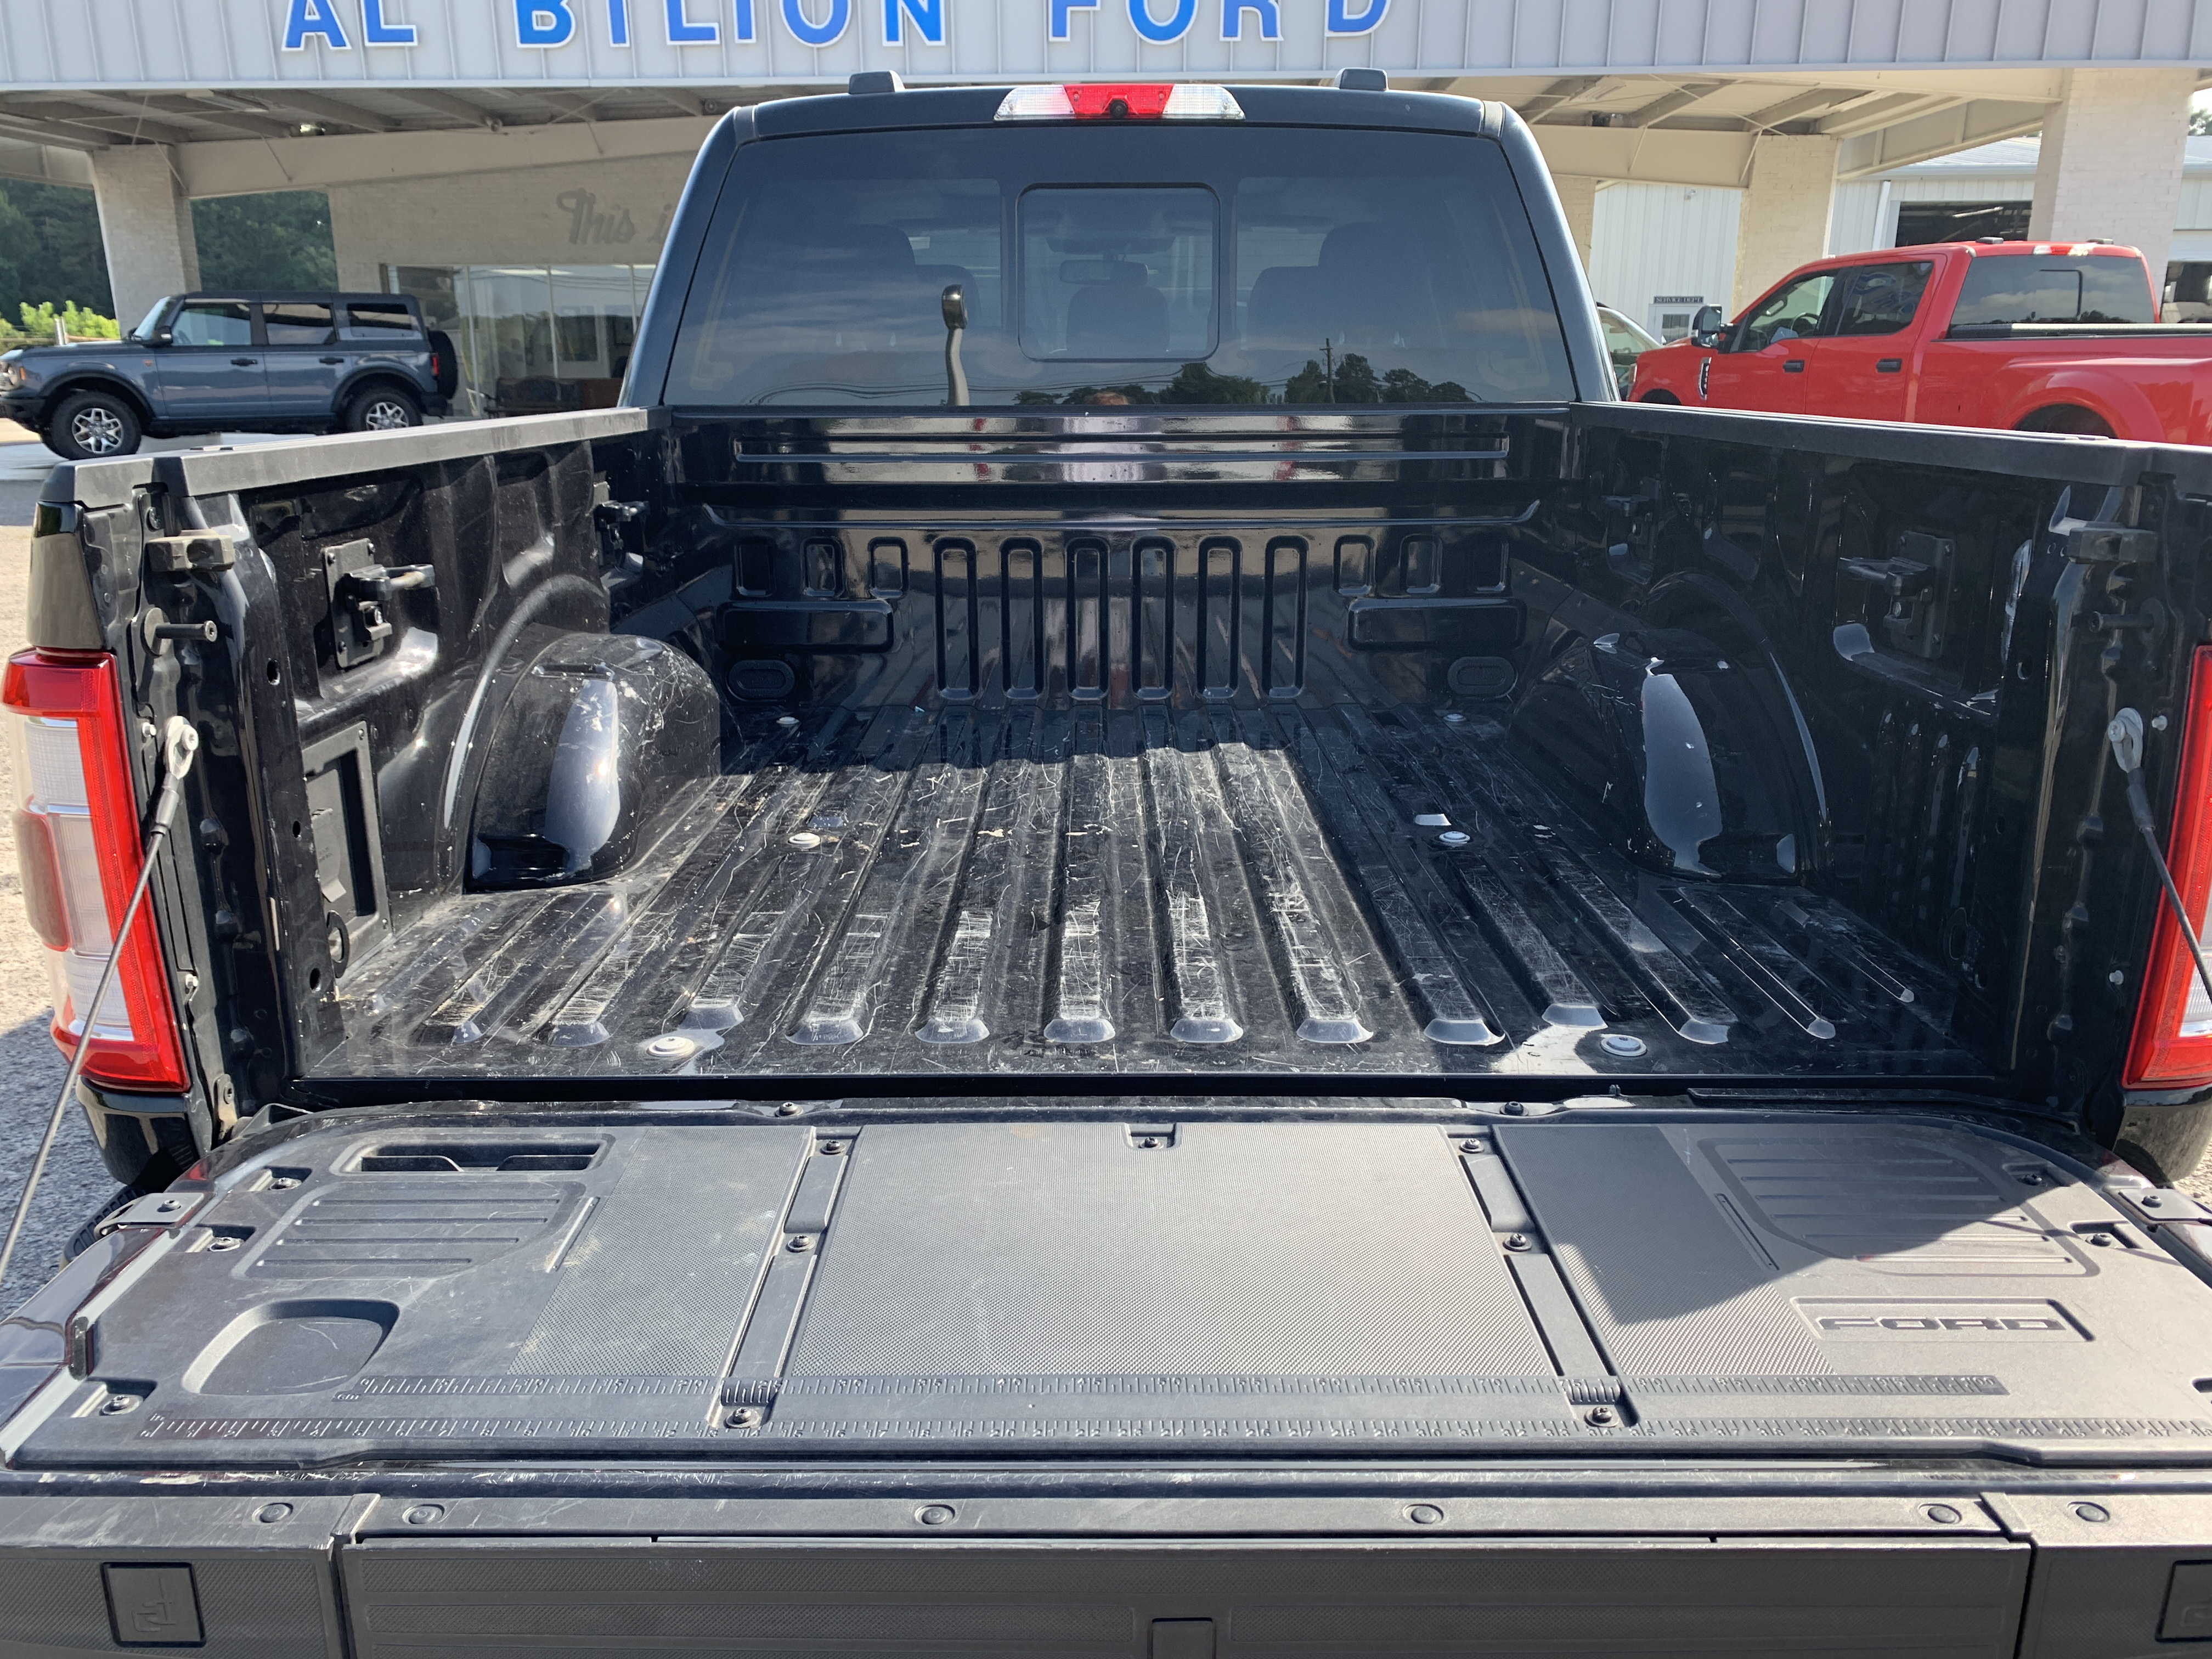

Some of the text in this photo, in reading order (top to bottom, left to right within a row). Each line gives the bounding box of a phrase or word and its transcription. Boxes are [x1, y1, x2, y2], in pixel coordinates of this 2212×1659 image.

[280, 0, 418, 51] AL
[556, 187, 635, 245] This
[1815, 1316, 2067, 1330] FORD
[758, 1380, 782, 1389] 25
[1317, 1378, 1342, 1386] 60
[1478, 1378, 1502, 1386] 70
[1560, 1378, 1582, 1386] 75
[1715, 1428, 1740, 1436] 37
